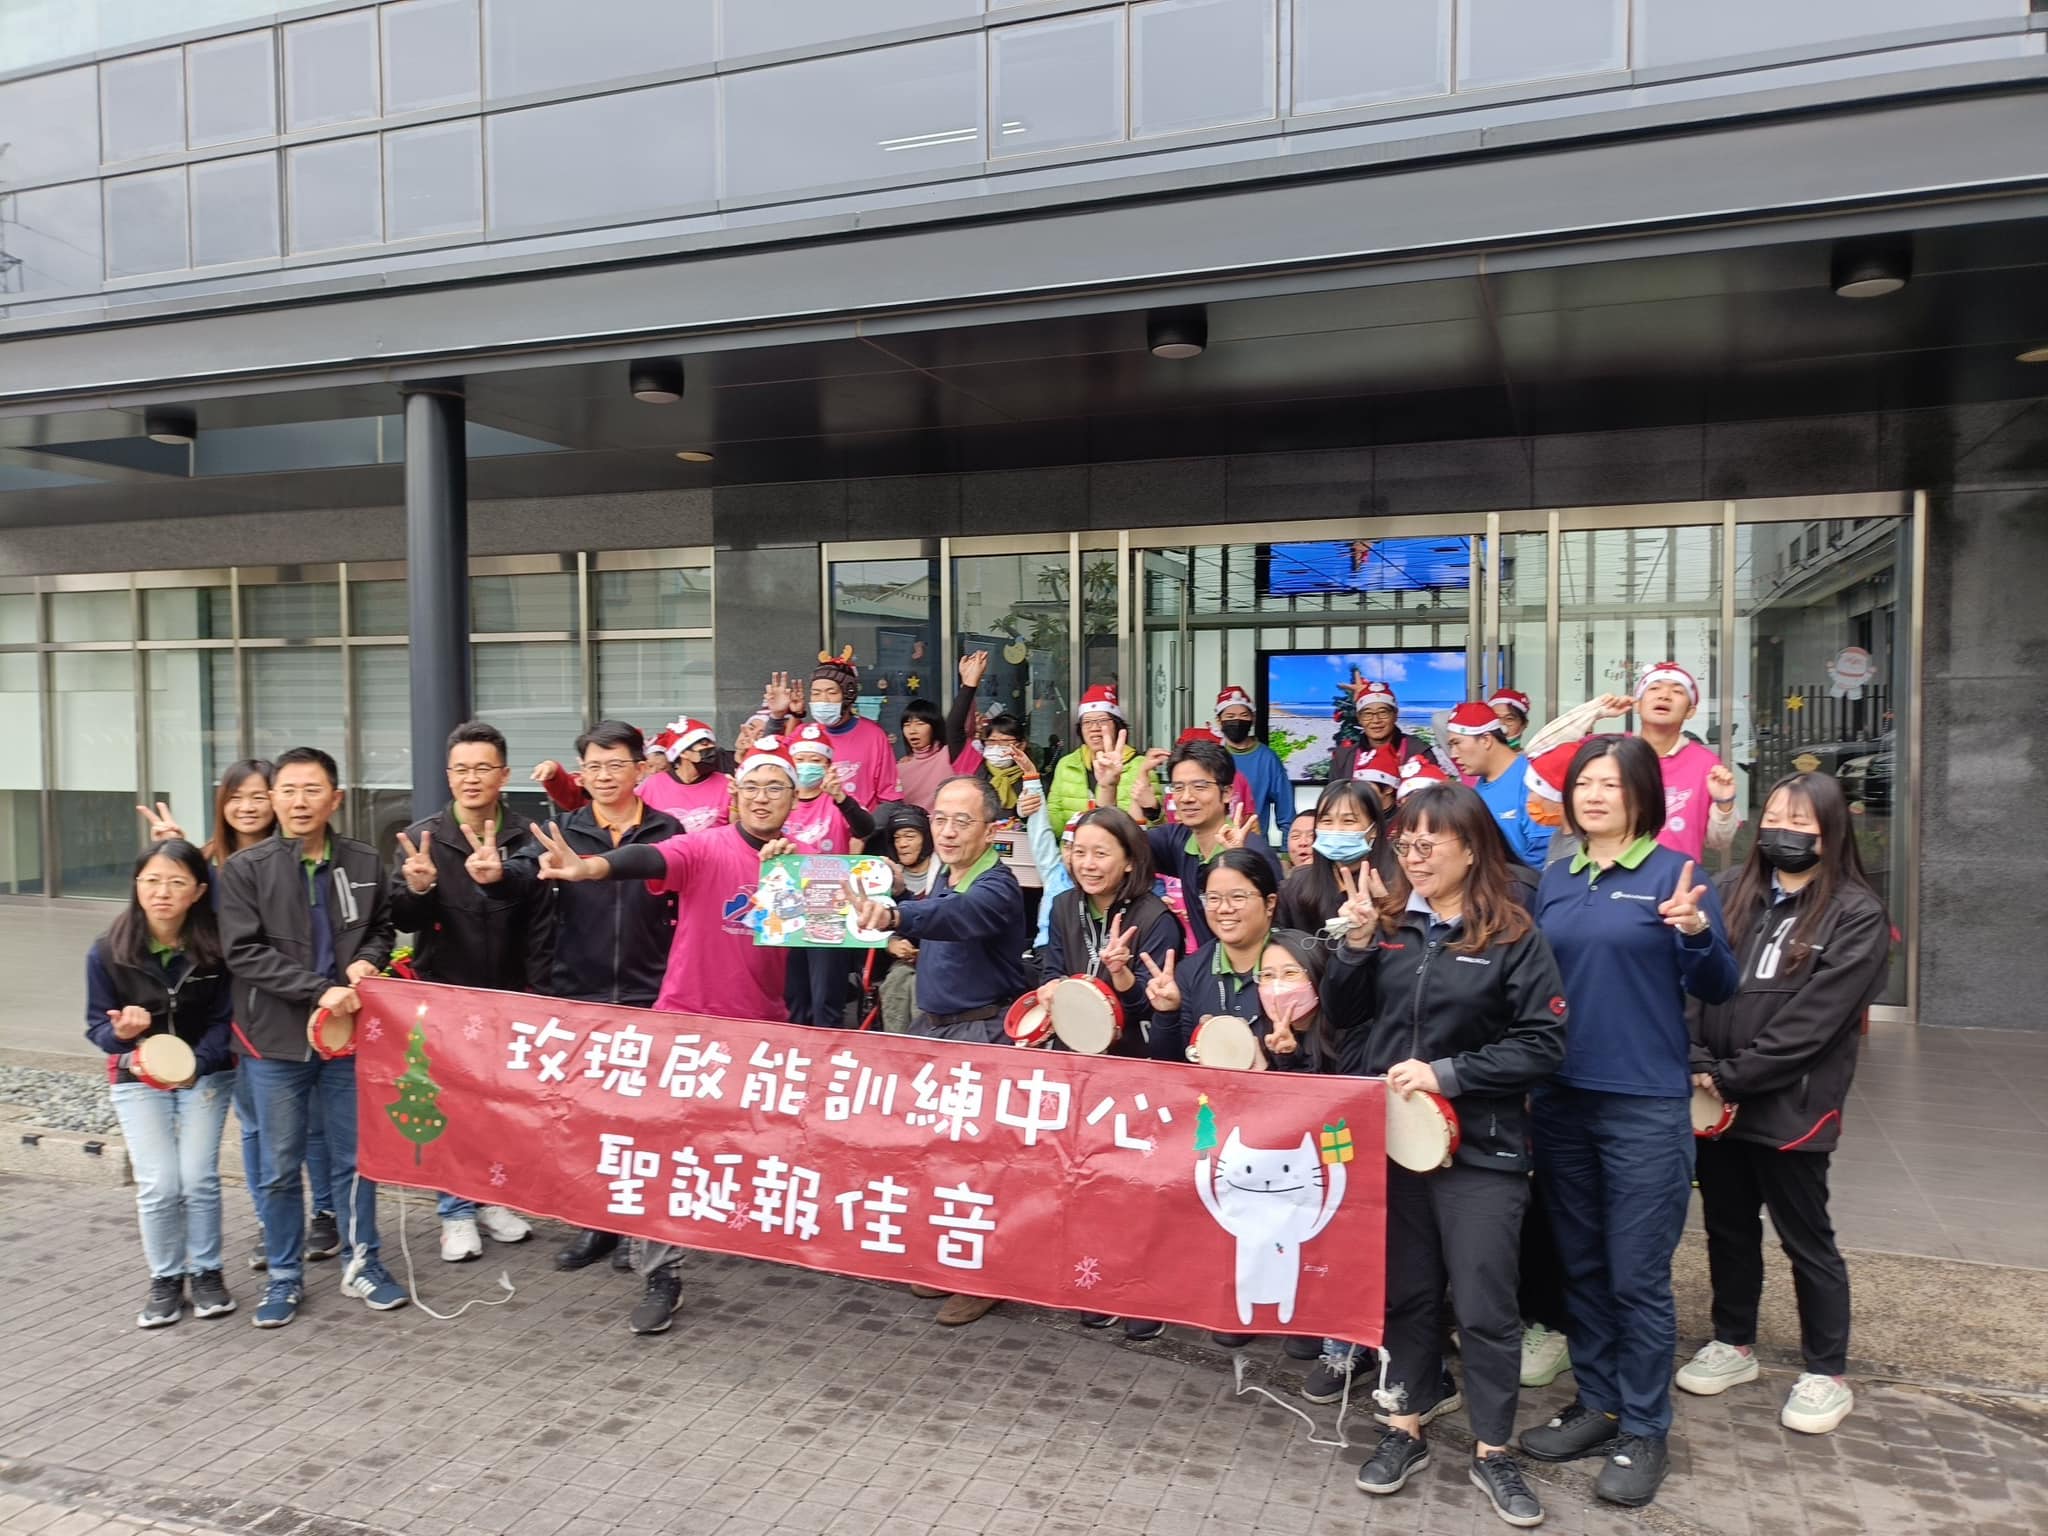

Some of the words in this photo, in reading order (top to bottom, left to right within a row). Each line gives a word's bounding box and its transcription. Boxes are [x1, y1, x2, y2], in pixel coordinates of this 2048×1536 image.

[506, 1017, 1173, 1150] 玫瑰啟能訓練中心
[596, 1133, 995, 1269] 聖誕報佳音
